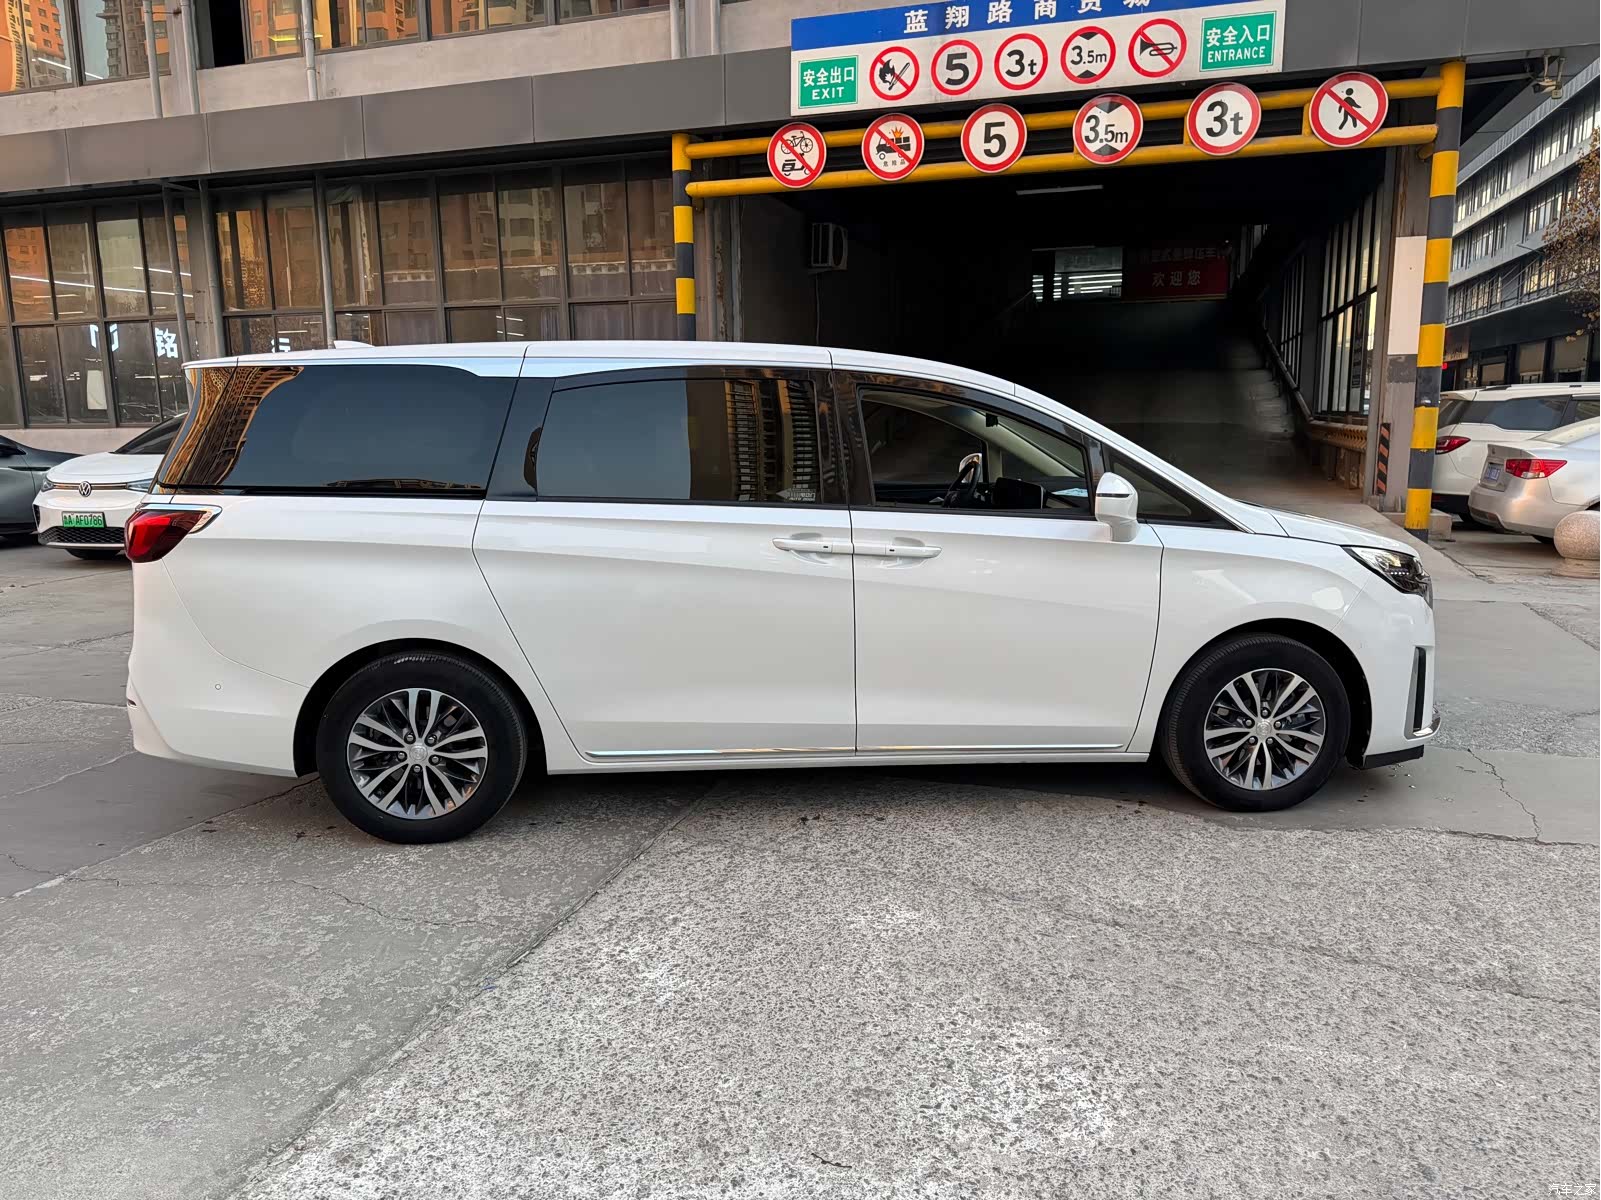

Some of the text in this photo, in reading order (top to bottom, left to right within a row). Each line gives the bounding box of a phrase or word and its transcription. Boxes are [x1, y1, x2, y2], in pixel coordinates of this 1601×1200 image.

[1205, 24, 1270, 48] 安全入口
[1005, 49, 1037, 78] 3t
[1070, 45, 1107, 66] 3.5m
[1207, 46, 1266, 63] ENTRANCE
[802, 66, 855, 87] 安全出口
[945, 52, 970, 86] 5
[811, 86, 845, 100] EXIT
[1084, 114, 1129, 145] 3.5m
[1205, 100, 1244, 138] 3t
[983, 121, 1007, 158] 5
[1151, 269, 1201, 288] 欢迎您
